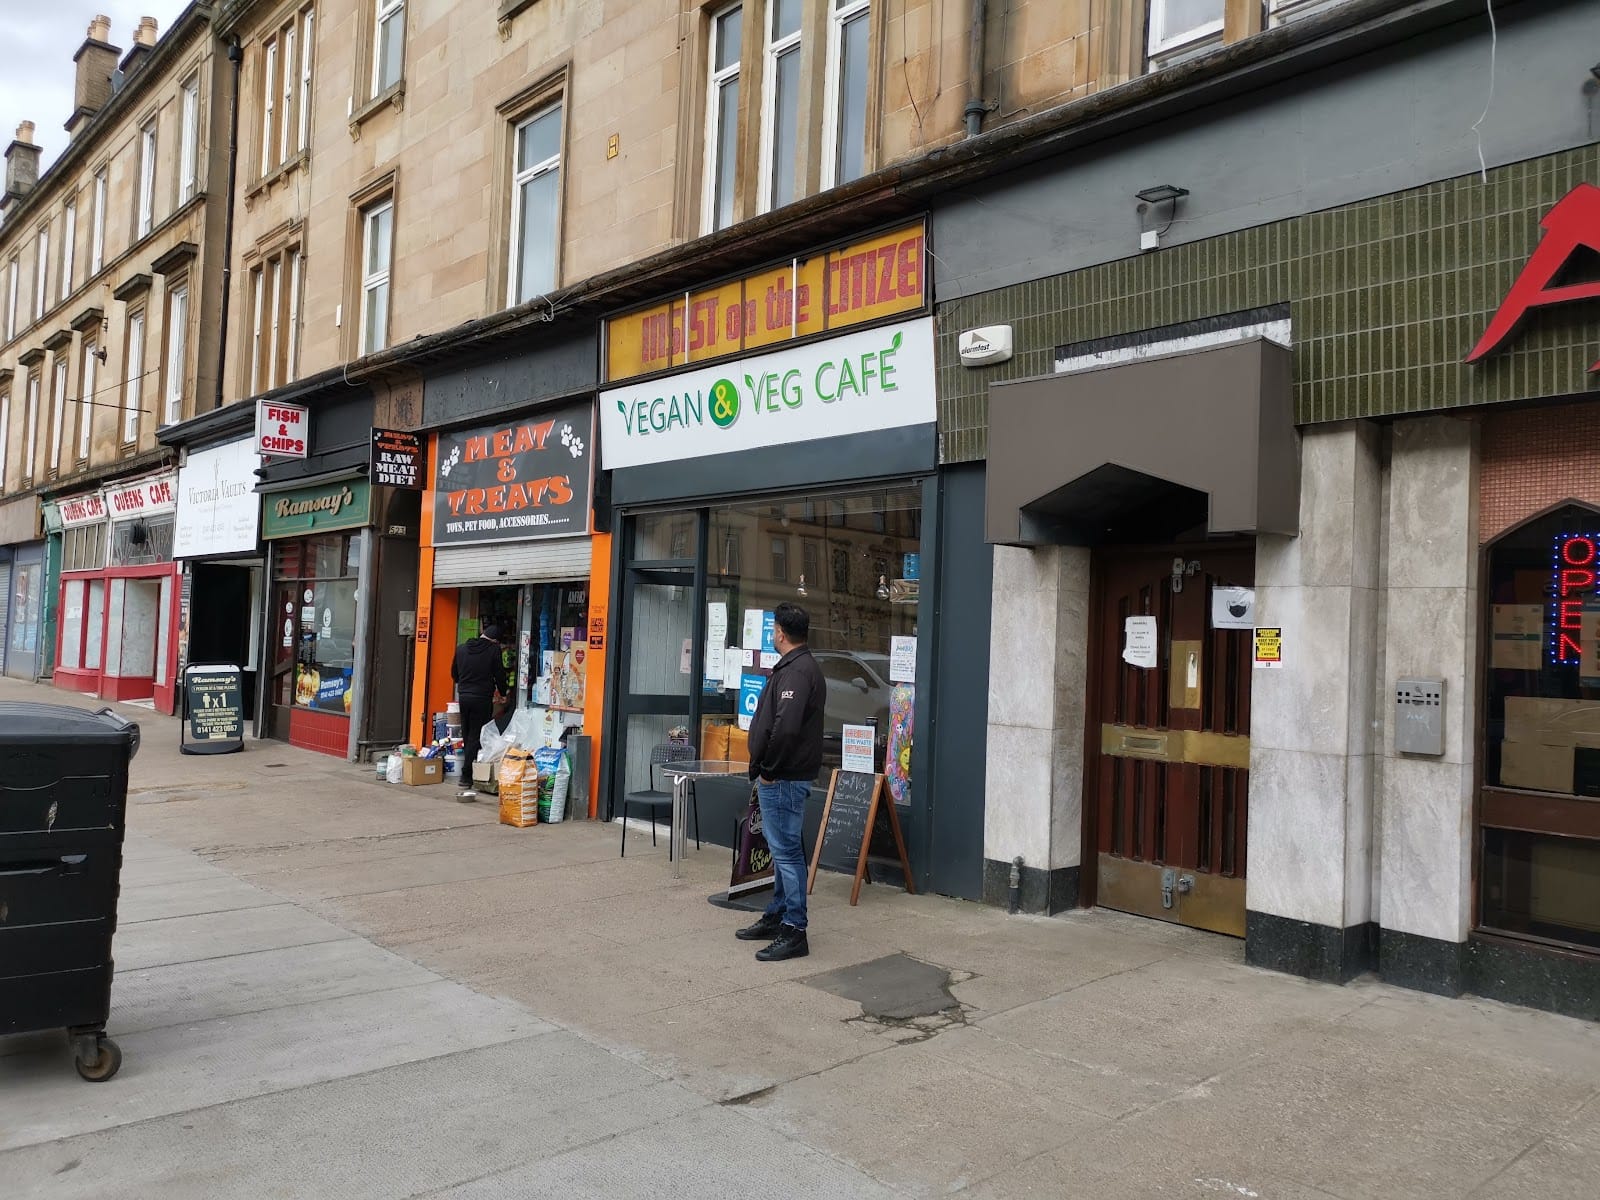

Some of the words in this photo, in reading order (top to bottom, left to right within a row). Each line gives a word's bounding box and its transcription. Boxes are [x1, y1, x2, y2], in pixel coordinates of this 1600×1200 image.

[726, 299, 756, 341] on
[765, 277, 809, 330] the
[617, 389, 703, 437] VEGAN
[745, 369, 801, 414] VEG
[268, 408, 300, 424] FISH
[278, 424, 288, 436] &
[464, 419, 555, 463] MEAT
[261, 436, 304, 452] CHIPS
[375, 462, 418, 476] MEAT
[380, 452, 415, 465] RAW
[497, 457, 516, 482] &
[378, 473, 416, 485] DIET
[113, 488, 145, 512] QUEENS
[149, 482, 171, 505] CAFE
[188, 487, 219, 505] VICTORIA
[221, 480, 247, 498] VAULTS
[275, 486, 353, 517] Ramsay's
[447, 475, 573, 517] TREATS
[63, 501, 86, 521] QUEENS
[86, 497, 104, 516] CAFE
[465, 520, 478, 532] PET
[478, 519, 499, 531] FOOD,
[1558, 536, 1597, 661] OPEN
[751, 853, 773, 873] crea
